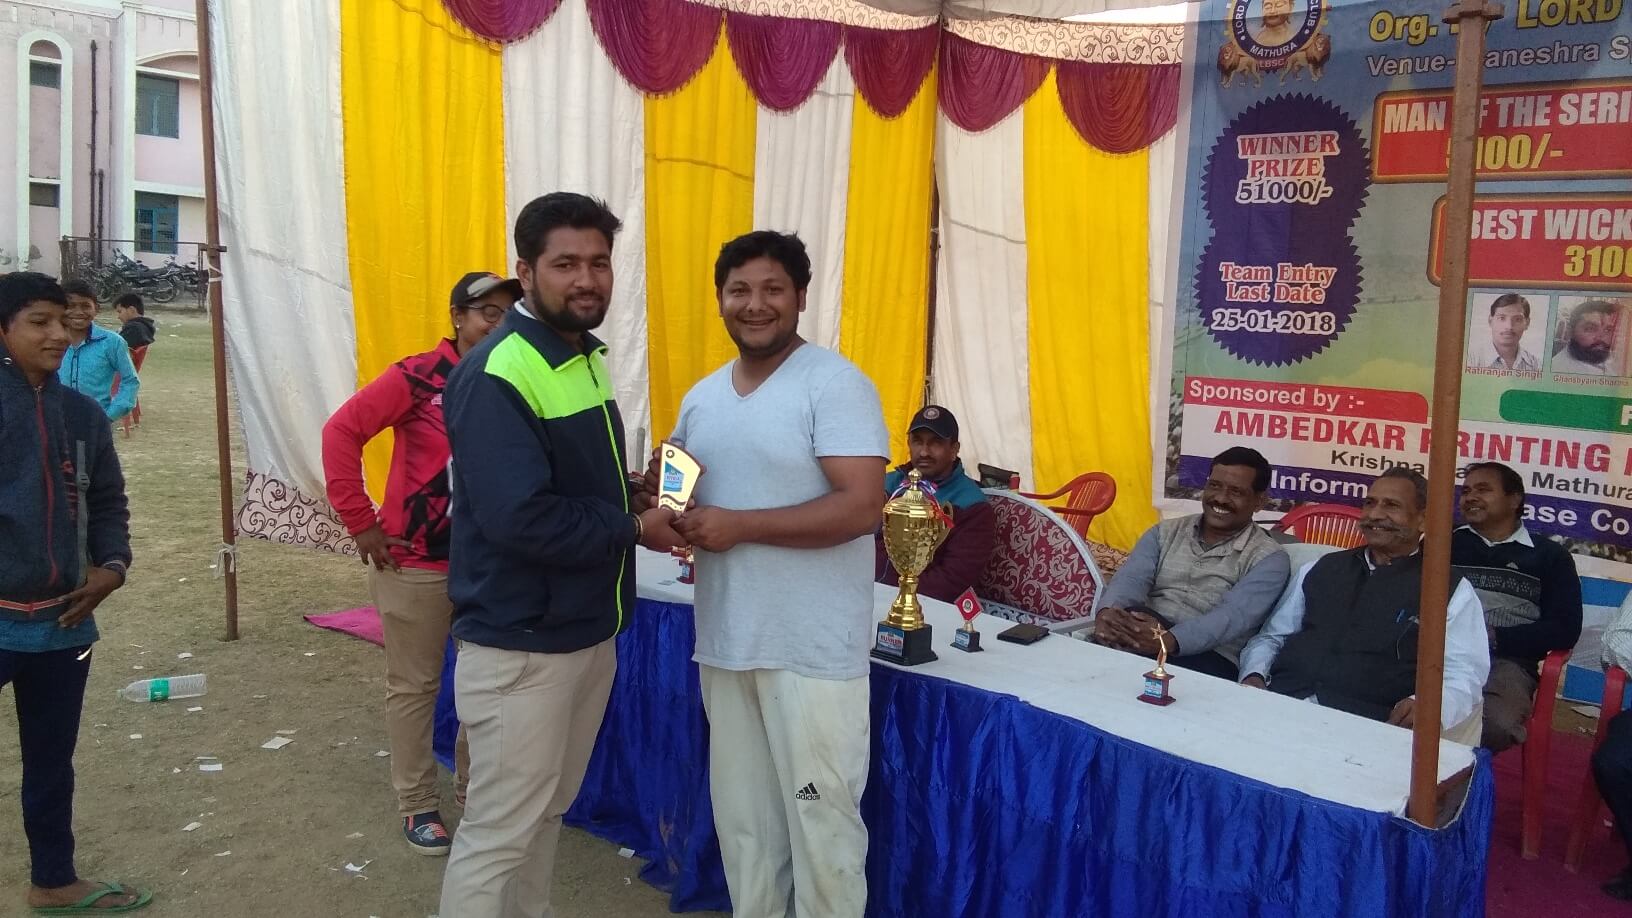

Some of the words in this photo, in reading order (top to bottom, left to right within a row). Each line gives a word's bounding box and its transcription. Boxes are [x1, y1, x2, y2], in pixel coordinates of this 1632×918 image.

[1235, 5, 1245, 34] LORD
[1369, 10, 1438, 46] Org.
[1517, 0, 1623, 29] LORD
[1250, 42, 1298, 58] MATHURA
[1367, 54, 1455, 77] Venue-
[1484, 40, 1600, 69] aneshra
[1608, 35, 1632, 64] S
[1383, 101, 1447, 134] MAN
[1496, 95, 1552, 128] THE
[1239, 133, 1338, 156] WINNER
[1446, 133, 1563, 171] 100/-
[1250, 157, 1322, 178] PRIZE
[1238, 179, 1330, 202] 51000/-
[1471, 208, 1538, 240] BEST
[1544, 208, 1632, 241] WICK
[1221, 263, 1272, 281] Team
[1278, 264, 1336, 287] Entry
[1227, 282, 1270, 301] Last
[1274, 283, 1325, 303] Date
[1213, 310, 1334, 333] 25-01-2018
[1515, 369, 1544, 380] Singh
[1189, 380, 1305, 404] Sponsored
[1313, 387, 1341, 412] by
[1213, 410, 1406, 451] AMBEDKAR
